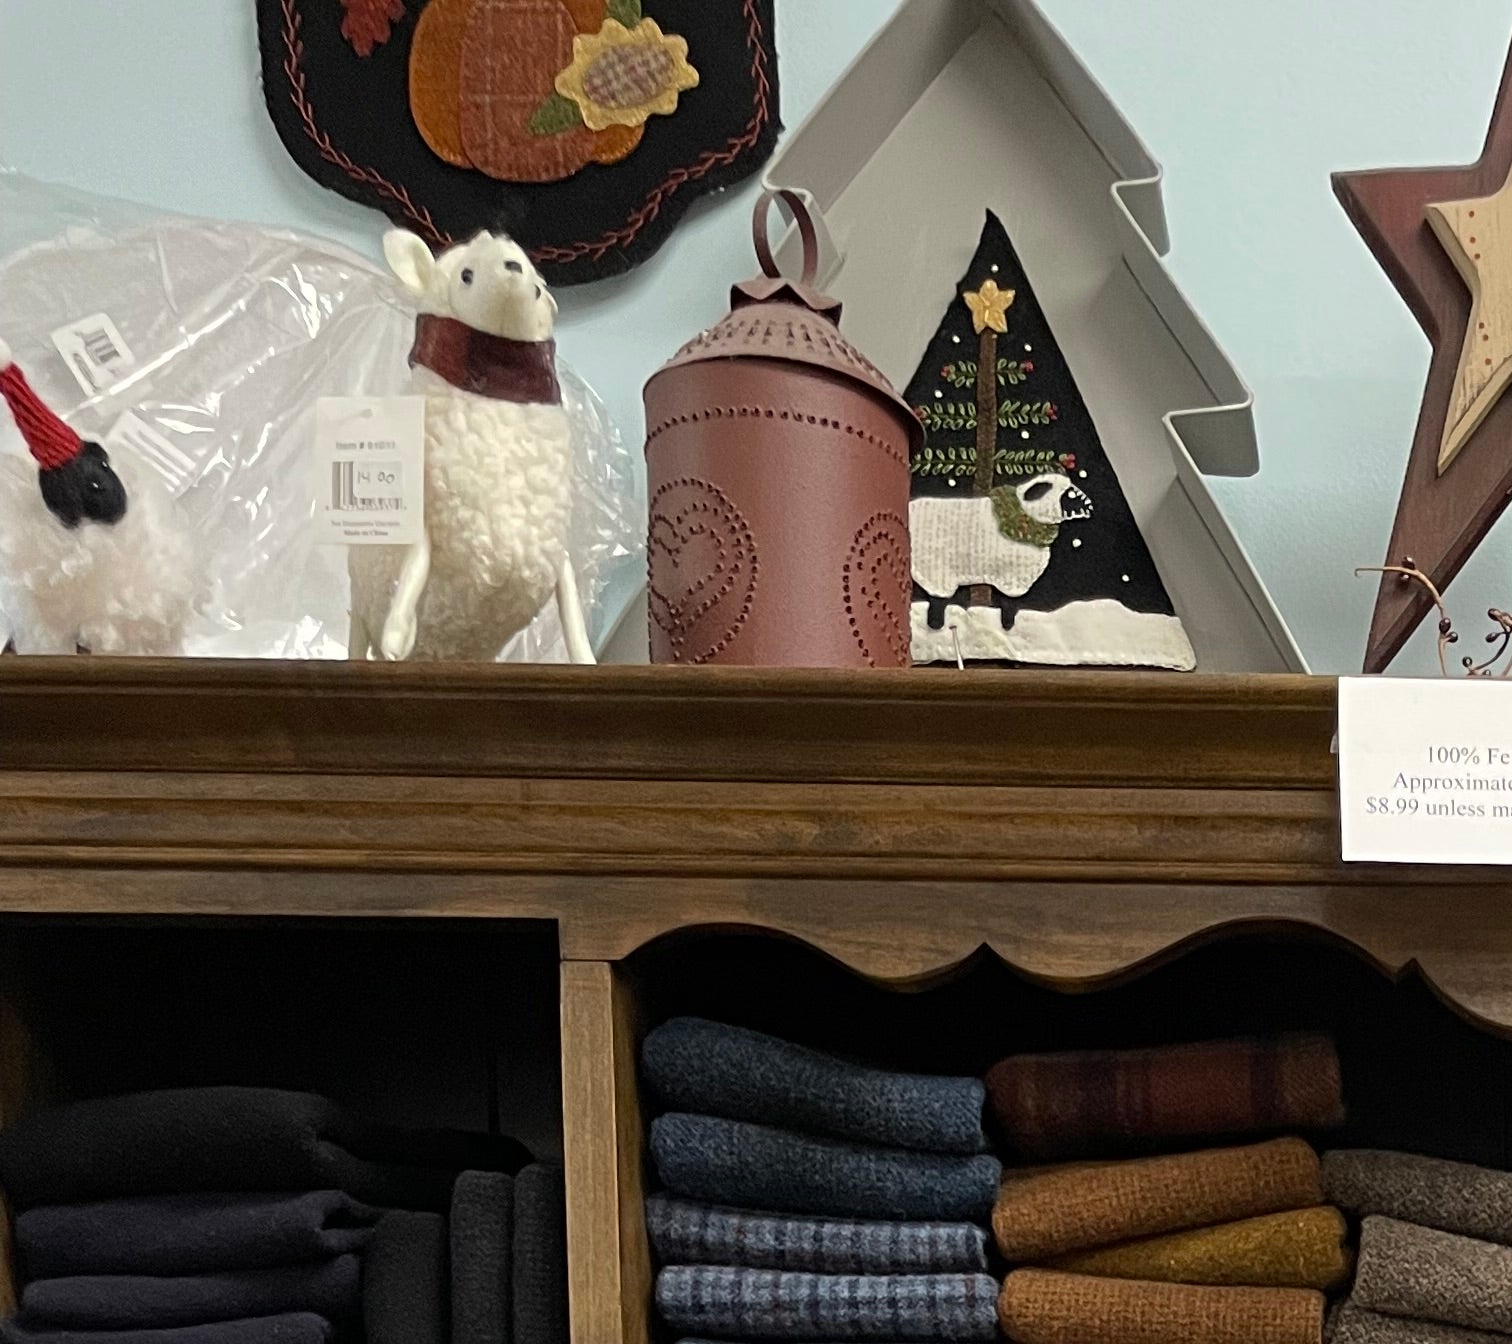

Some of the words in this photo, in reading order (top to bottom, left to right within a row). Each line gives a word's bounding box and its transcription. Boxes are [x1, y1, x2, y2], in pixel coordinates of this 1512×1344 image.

[1427, 745, 1481, 766] 100%
[1366, 797, 1419, 816] $8.99
[1425, 799, 1486, 818] unless
